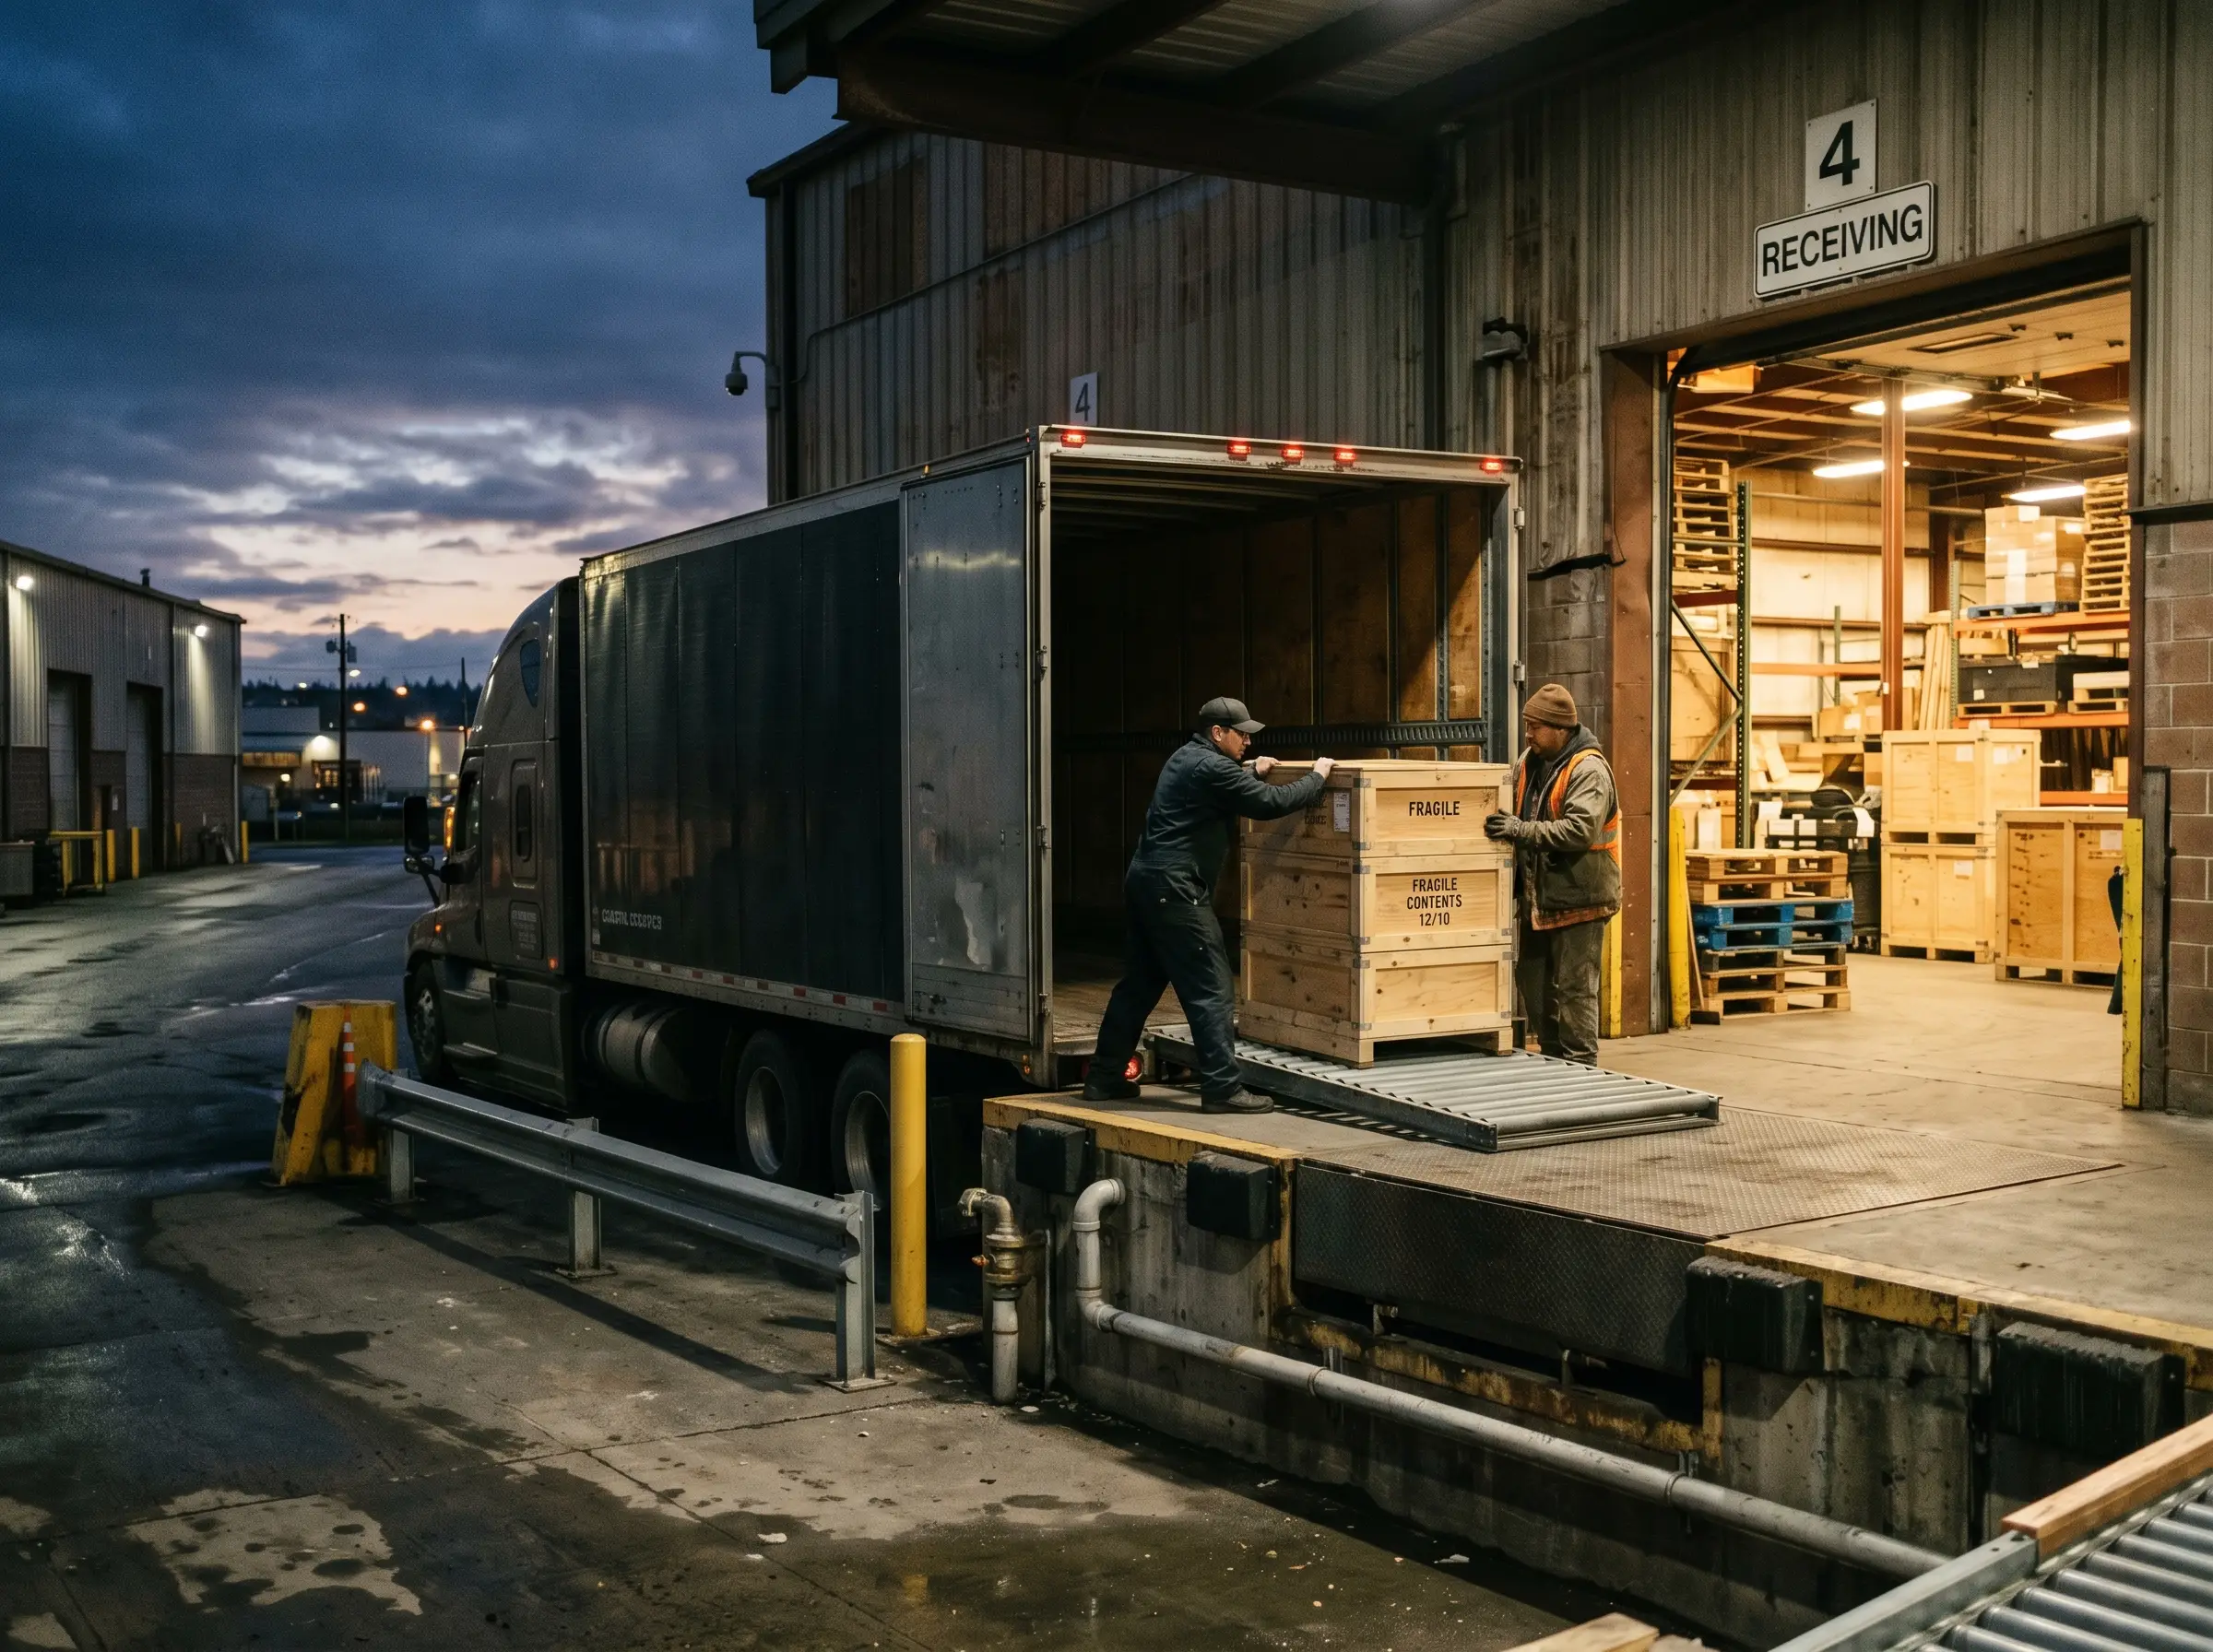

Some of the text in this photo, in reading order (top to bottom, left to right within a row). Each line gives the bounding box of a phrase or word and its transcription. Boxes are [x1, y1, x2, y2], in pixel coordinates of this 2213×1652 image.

[1819, 120, 1860, 186] 4
[1762, 204, 1923, 277] RECEIVING
[1075, 383, 1091, 422] 4
[1409, 800, 1461, 817] FRAGILE
[1413, 878, 1458, 892] FRAGILE
[1406, 894, 1462, 910] CONTENTS
[1419, 913, 1450, 926] 12/10
